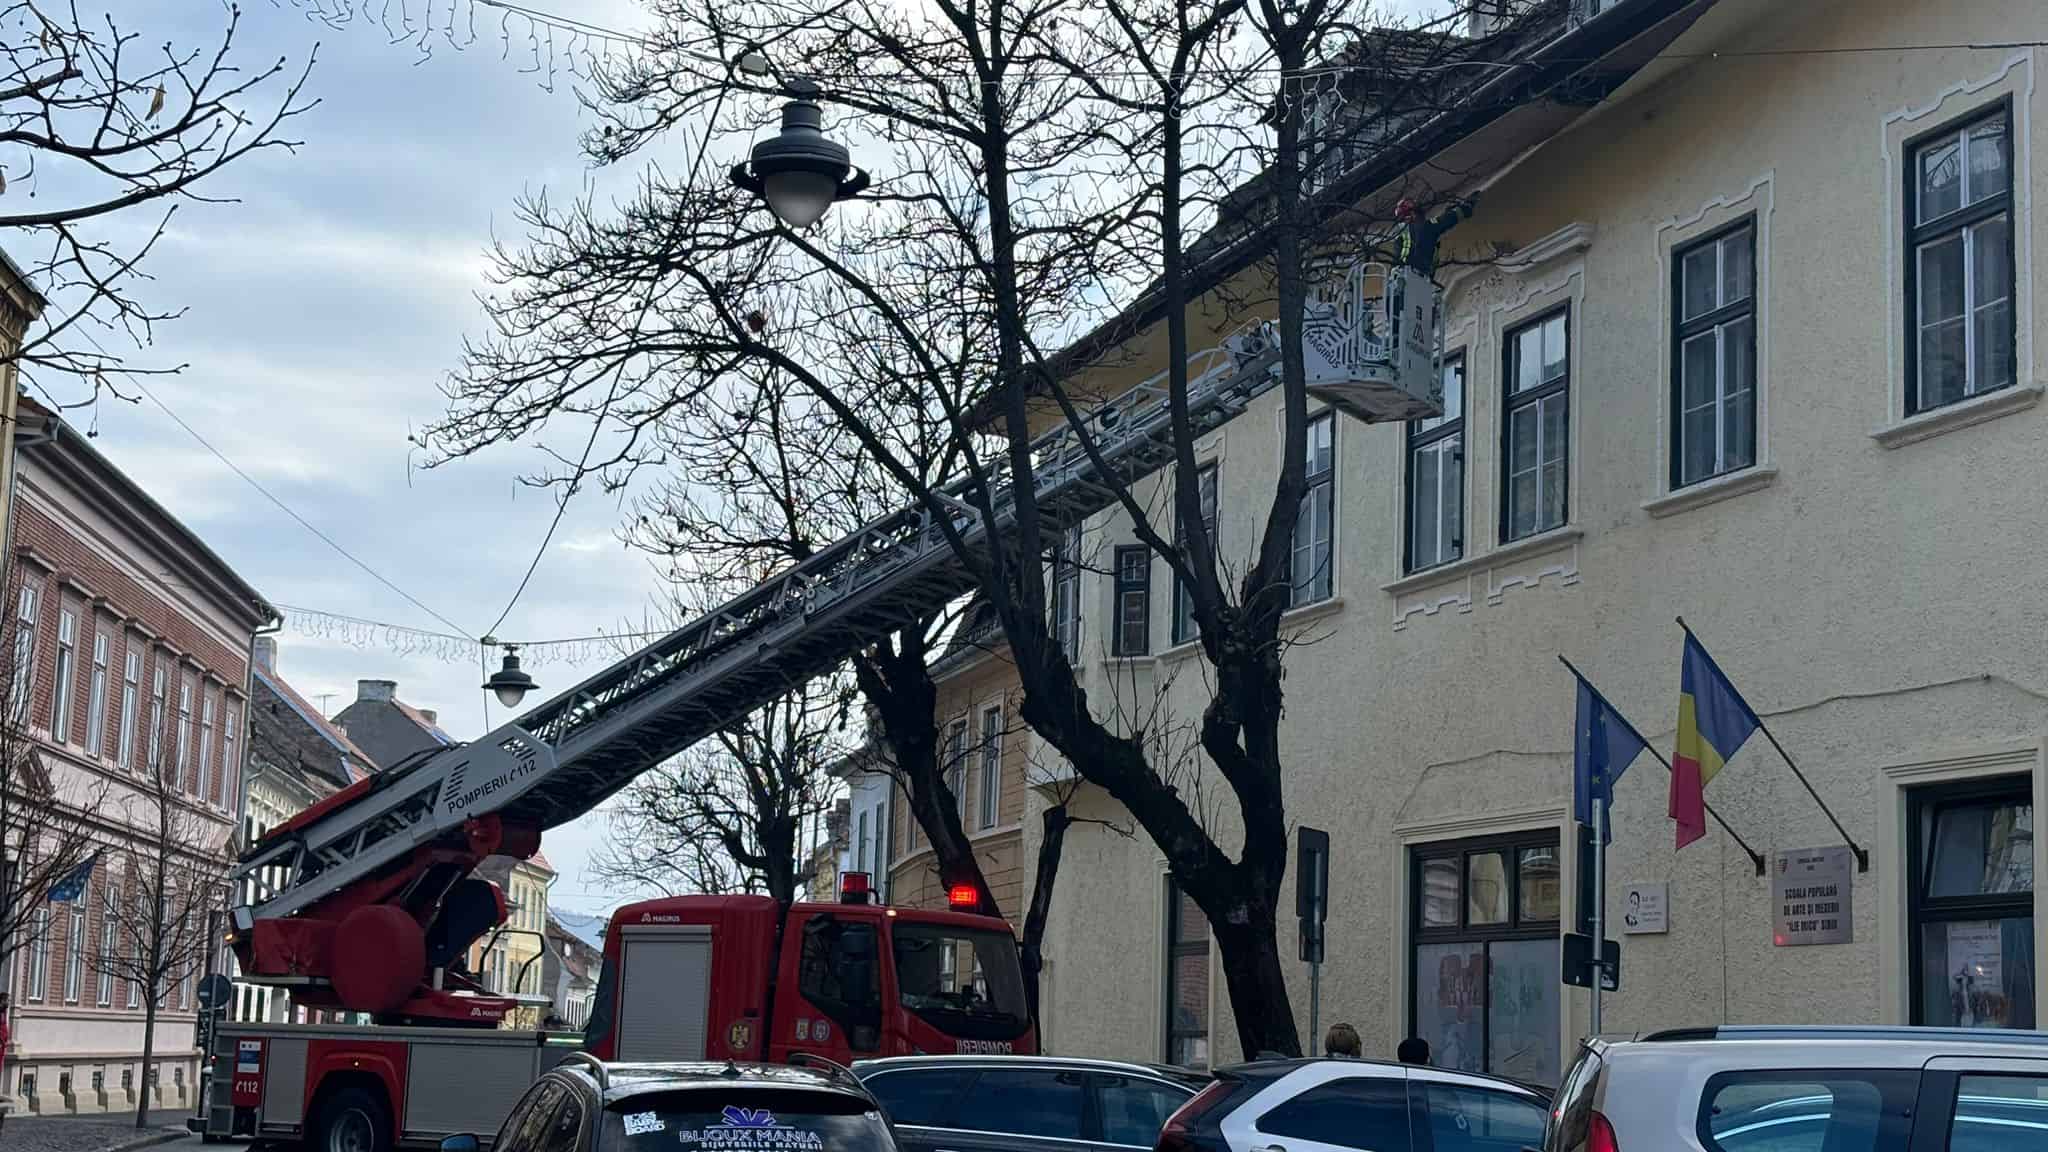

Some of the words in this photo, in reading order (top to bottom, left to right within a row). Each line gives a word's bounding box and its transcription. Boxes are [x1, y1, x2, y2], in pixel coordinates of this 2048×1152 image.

[1304, 331, 1341, 369] MAGIRUS
[448, 774, 508, 814] POMPIERII
[517, 759, 537, 777] 112
[243, 1081, 259, 1093] 112
[679, 1129, 752, 1143] BIJOUX
[756, 1130, 822, 1144] MANIA
